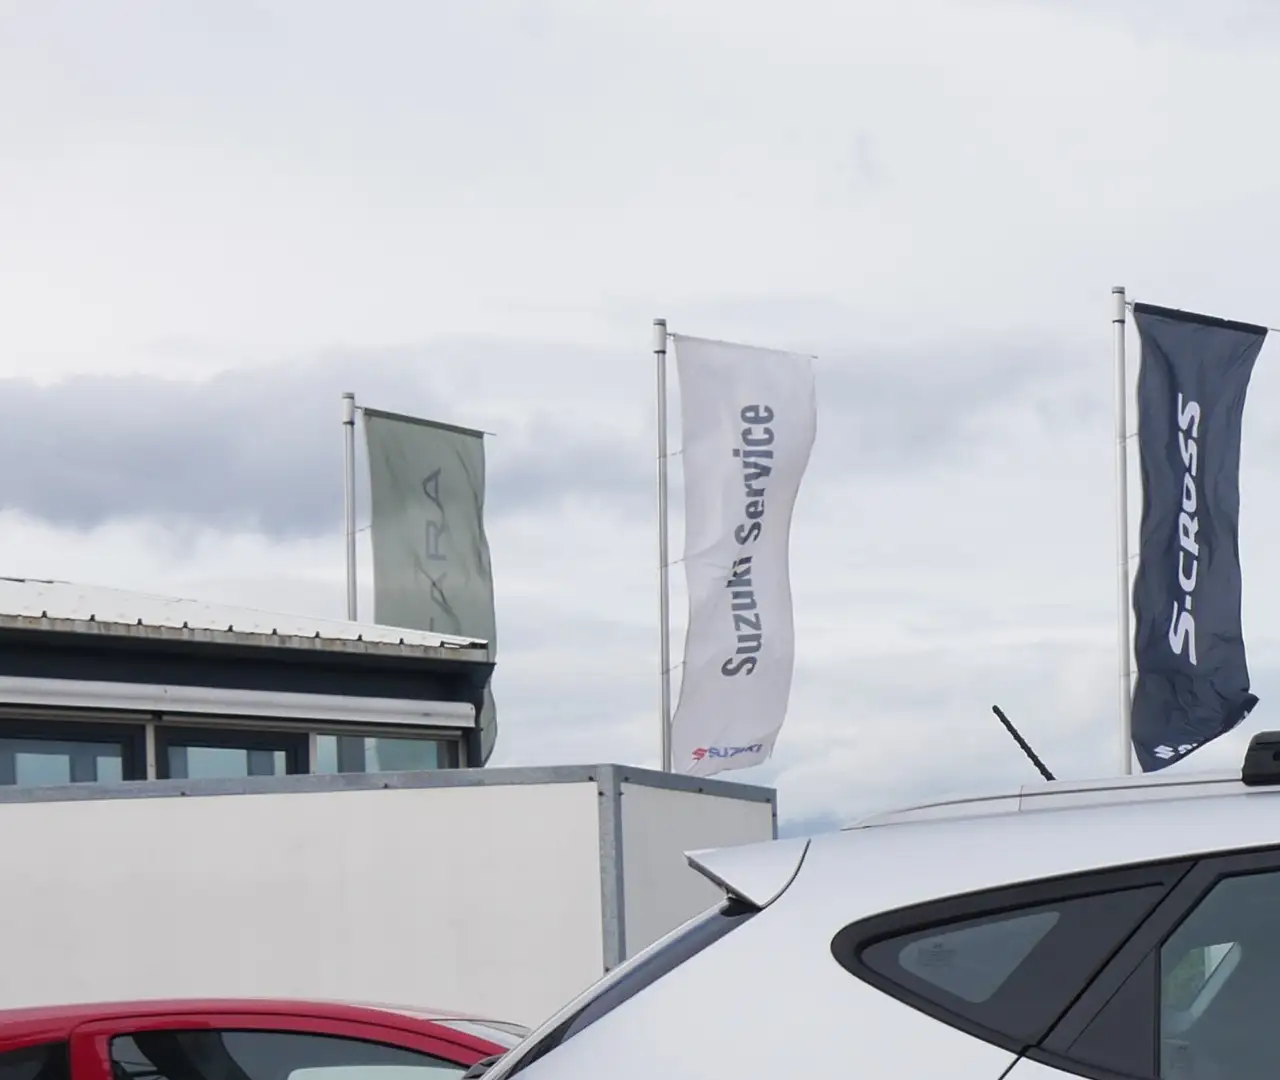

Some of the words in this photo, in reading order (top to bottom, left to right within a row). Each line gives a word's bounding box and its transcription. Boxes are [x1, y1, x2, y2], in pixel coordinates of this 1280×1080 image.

[732, 404, 775, 546] Service
[1168, 392, 1201, 666] S-CROSS
[721, 555, 763, 677] Suzuki
